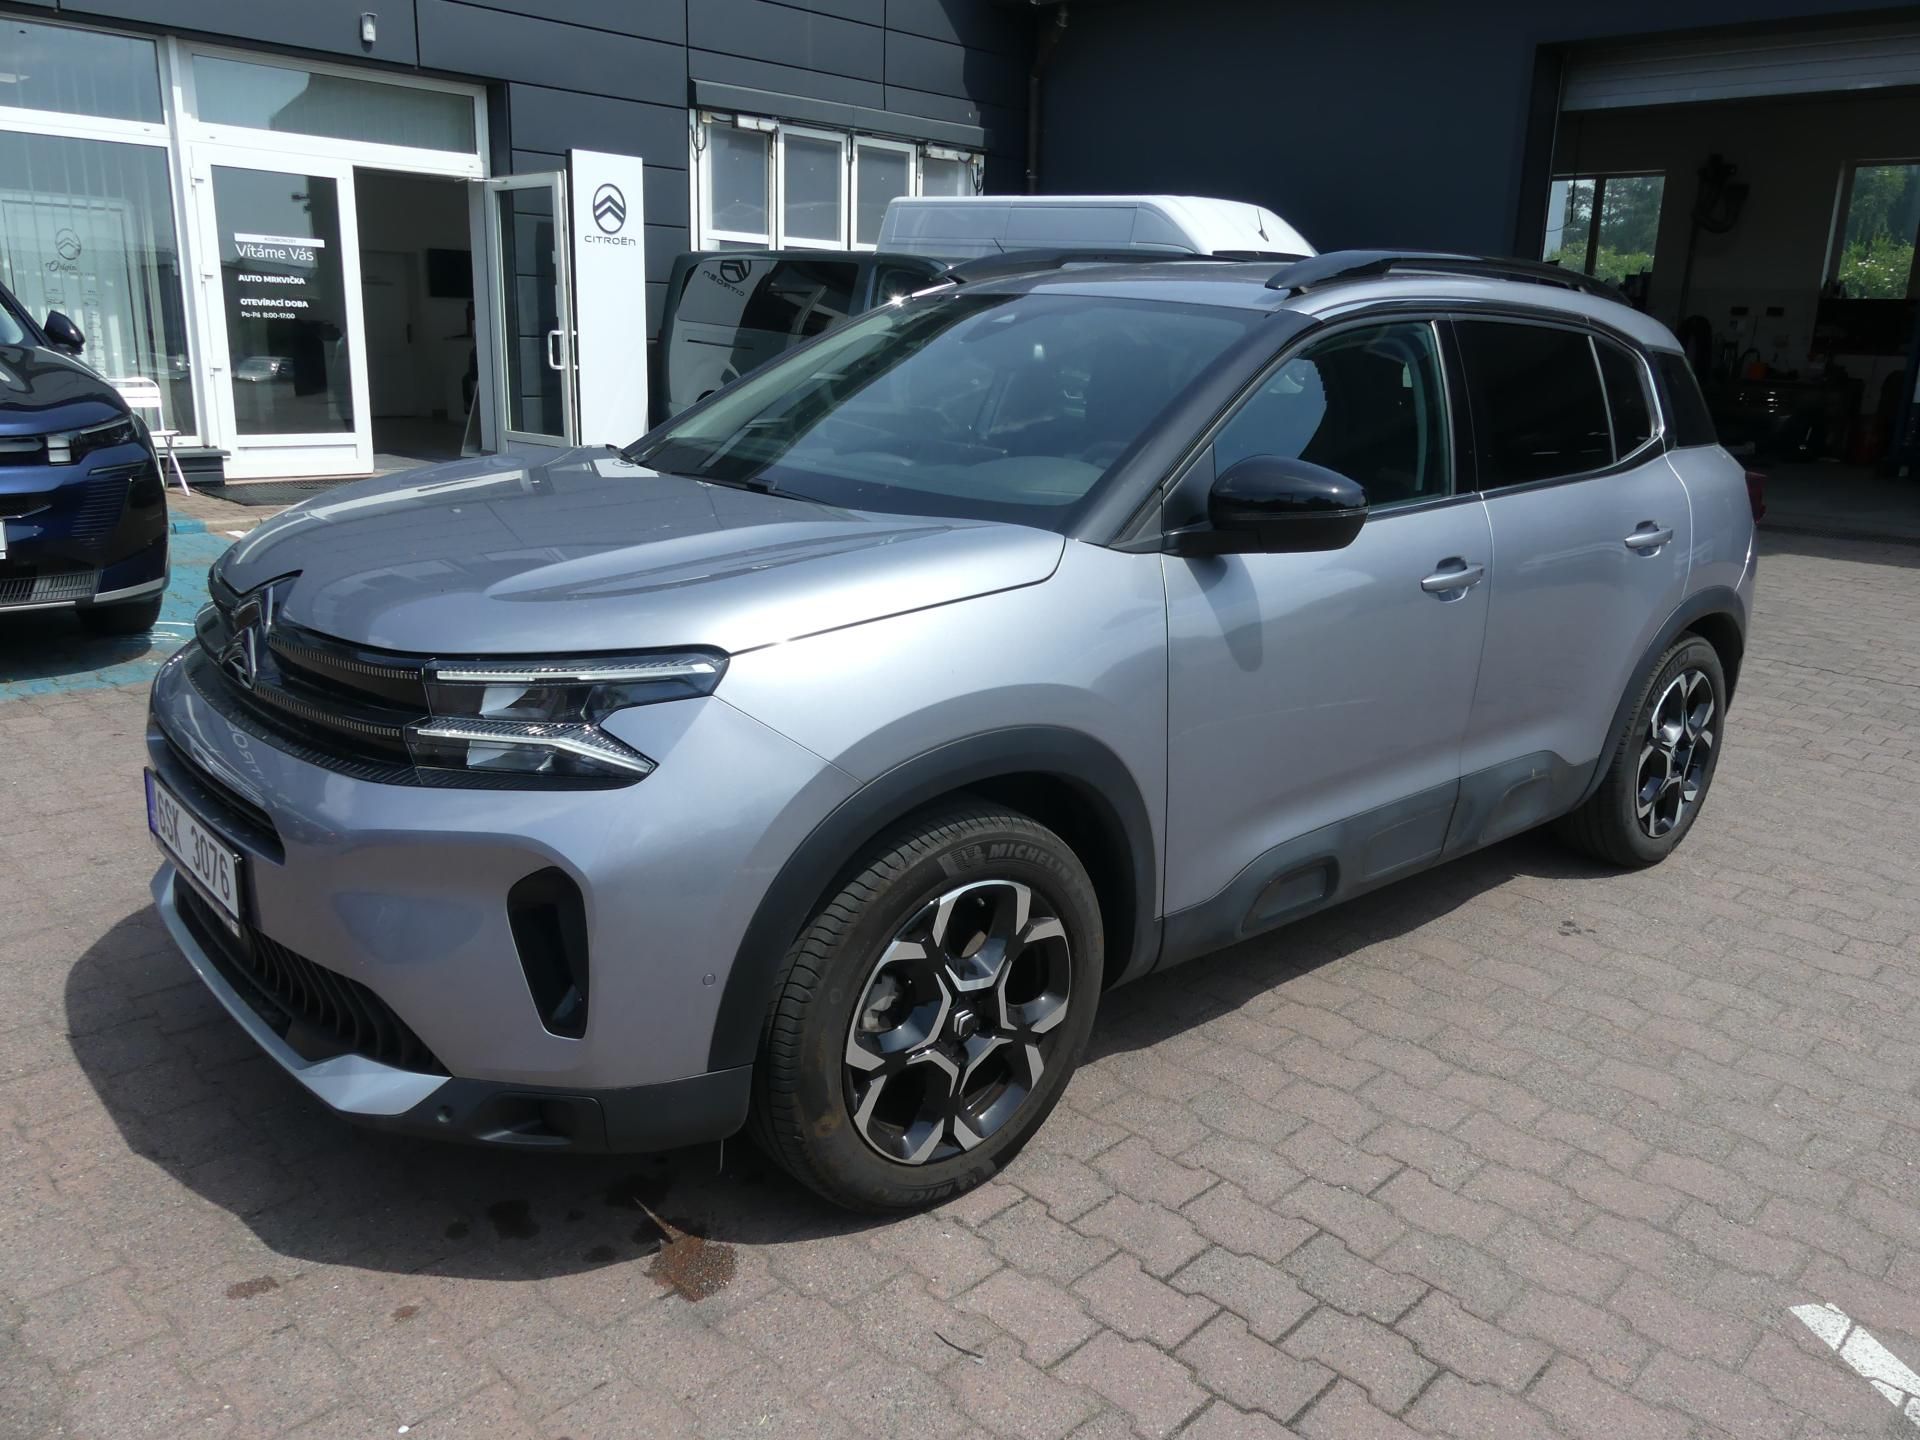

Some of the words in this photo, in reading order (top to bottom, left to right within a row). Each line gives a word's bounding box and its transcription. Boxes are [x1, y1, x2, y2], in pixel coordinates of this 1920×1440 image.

[235, 243, 286, 259] Vítáme
[288, 247, 314, 261] Vás
[238, 274, 262, 282] AUTO
[263, 276, 306, 284] MRKVIČKA
[240, 298, 284, 307] OTEVÍRACÍ
[284, 300, 309, 308] DOBA
[157, 790, 183, 853] 6SK
[191, 825, 231, 901] 3076
[989, 843, 1073, 881] MICHELIN
